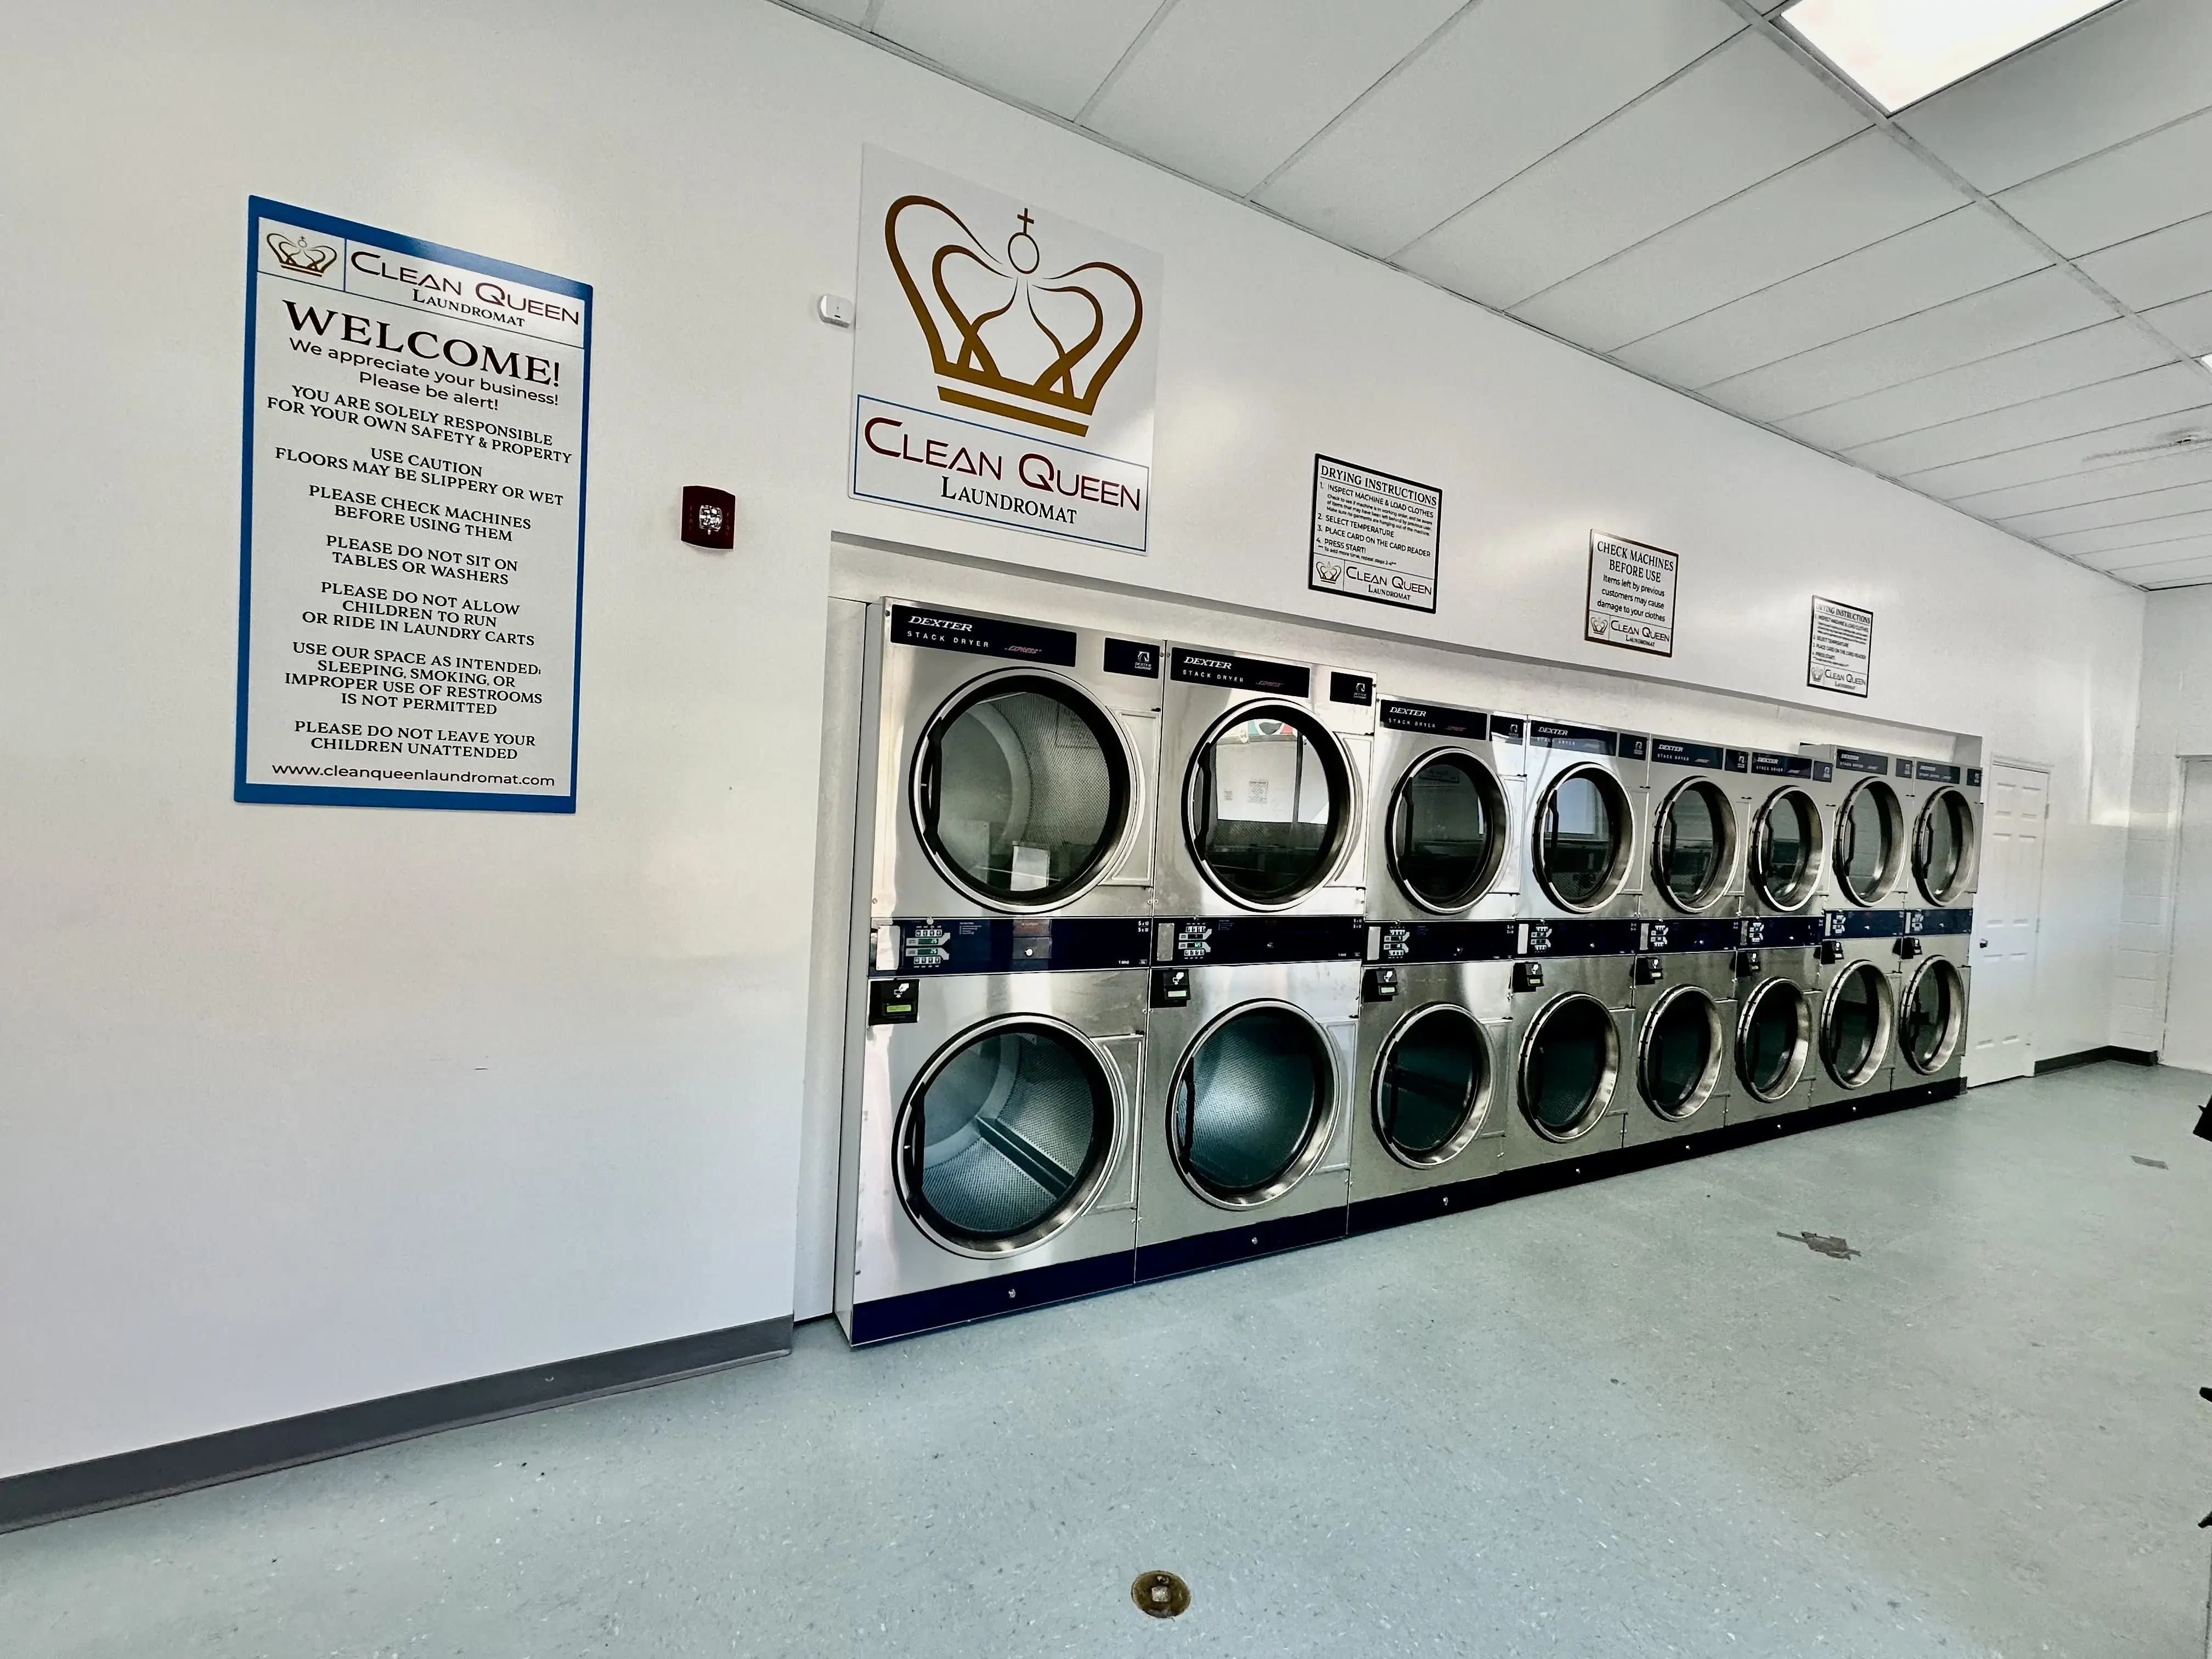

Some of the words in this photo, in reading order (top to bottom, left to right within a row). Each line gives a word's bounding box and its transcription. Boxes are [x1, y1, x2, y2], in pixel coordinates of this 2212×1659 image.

[351, 251, 462, 295] CLEAN
[476, 283, 579, 325] QUEEN
[413, 289, 525, 326] LAUNDROMAT
[282, 300, 559, 387] WELCOME!
[289, 337, 321, 355] We
[328, 349, 430, 377] appreciate
[434, 371, 475, 387] your
[481, 378, 558, 405] business!
[360, 371, 420, 394] Please
[426, 385, 448, 400] be
[454, 392, 498, 410] alert!
[292, 385, 329, 402] YOU
[334, 394, 370, 410] ARE
[375, 402, 439, 424] SOLELY
[444, 415, 552, 445] RESPONSIBLE
[267, 397, 304, 414] FOR
[310, 405, 359, 425] YOUR
[364, 416, 407, 433] OWN
[411, 424, 475, 445] SAFETY
[479, 437, 487, 448] &
[492, 439, 572, 464] PROPERTY
[276, 447, 348, 469] FLOORS
[353, 460, 390, 476] MAY
[395, 467, 416, 481] BE
[421, 472, 498, 494] SLIPPERY
[503, 486, 524, 499] OR
[528, 490, 563, 505] WET
[371, 448, 403, 464] USE
[408, 455, 482, 477] CAUTION
[865, 418, 1002, 481] CLEAN
[1019, 454, 1140, 511] QUEEN
[941, 476, 1077, 524] LAUNDROMAT
[1321, 466, 1362, 485] DRYING
[1365, 478, 1436, 505] INSTRUCTIONS
[309, 485, 376, 505] PLEASE
[381, 497, 441, 516] CHECK
[445, 506, 531, 529] MACHINES
[1328, 484, 1353, 496] INSPECT
[1355, 492, 1383, 505] MACHINE
[1390, 501, 1407, 510] LOAD
[1408, 506, 1433, 518] CLOTHES
[335, 505, 405, 525] BEFORE
[410, 516, 460, 533] USING
[465, 524, 512, 541] THEM
[1325, 515, 1349, 526] SELECT
[1350, 521, 1394, 538] TEMPERATURE
[326, 535, 392, 554] PLEASE
[398, 545, 422, 558] DO
[428, 549, 462, 563] NOT
[466, 555, 490, 567] SIT
[495, 559, 517, 571] ON
[1324, 538, 1344, 549] PRESS
[1346, 544, 1365, 553] START!
[1325, 526, 1345, 537] PLACE
[1347, 532, 1364, 541] CARD
[1376, 539, 1388, 547] THE
[1390, 542, 1406, 551] CARD
[1407, 546, 1430, 557] READER
[1598, 541, 1628, 558] CHECK
[1630, 550, 1673, 571] MACHINES
[332, 552, 397, 570] TABLES
[402, 561, 426, 574] OR
[431, 565, 508, 584] WASHERS
[1346, 566, 1387, 586] CLEAN
[1392, 576, 1431, 595] QUEEN
[1609, 560, 1644, 578] BEFORE
[1646, 569, 1661, 583] USE
[321, 582, 387, 600] PLEASE
[393, 590, 417, 603] DO
[422, 594, 457, 607] NOT
[461, 599, 520, 614] ALLOW
[1368, 584, 1410, 600] LAUNDROMAT
[1602, 589, 1633, 601] customers
[1634, 596, 1647, 606] may
[1648, 600, 1664, 609] cause
[1622, 579, 1631, 588] left
[1633, 582, 1640, 591] by
[1641, 585, 1664, 597] previous
[343, 601, 432, 620] CHILDREN
[437, 611, 459, 623] TO
[464, 614, 496, 627] RUN
[909, 616, 972, 631] DEXTER
[1597, 600, 1622, 612] damage
[1645, 612, 1665, 622] clothes
[302, 612, 328, 624] OR
[334, 614, 375, 629] RIDE
[380, 619, 398, 631] IN
[404, 622, 481, 640] LAUNDRY
[486, 631, 534, 646] CARTS
[907, 631, 944, 641] STACK
[953, 637, 988, 647] DRYER
[1611, 620, 1639, 635] CLEAN
[1642, 627, 1669, 642] QUEEN
[293, 642, 326, 655] USE
[332, 646, 370, 659] OUR
[374, 650, 426, 664] SPACE
[431, 656, 451, 667] AS
[1184, 657, 1232, 669] DEXTER
[285, 673, 378, 691] IMPROPER
[383, 681, 414, 693] USE
[419, 684, 442, 695] OF
[447, 686, 542, 703] RESTROOMS
[493, 676, 515, 687] OR
[1217, 674, 1243, 682] DRYER
[1825, 669, 1844, 681] CLEAN
[342, 693, 357, 704] IS
[362, 695, 398, 707] NOT
[403, 698, 496, 714] PERMITTED
[1390, 707, 1426, 716] DEXTER
[295, 721, 362, 735] PLEASE
[368, 725, 392, 737] DO
[398, 727, 433, 740] NOT
[438, 730, 489, 743] LEAVE
[494, 733, 535, 746] YOUR
[1538, 727, 1568, 735] DEXTER
[311, 738, 403, 753] CHILDREN
[408, 743, 517, 759] UNATTENDED
[272, 765, 554, 786] www.cleanqueenlaundromat.com
